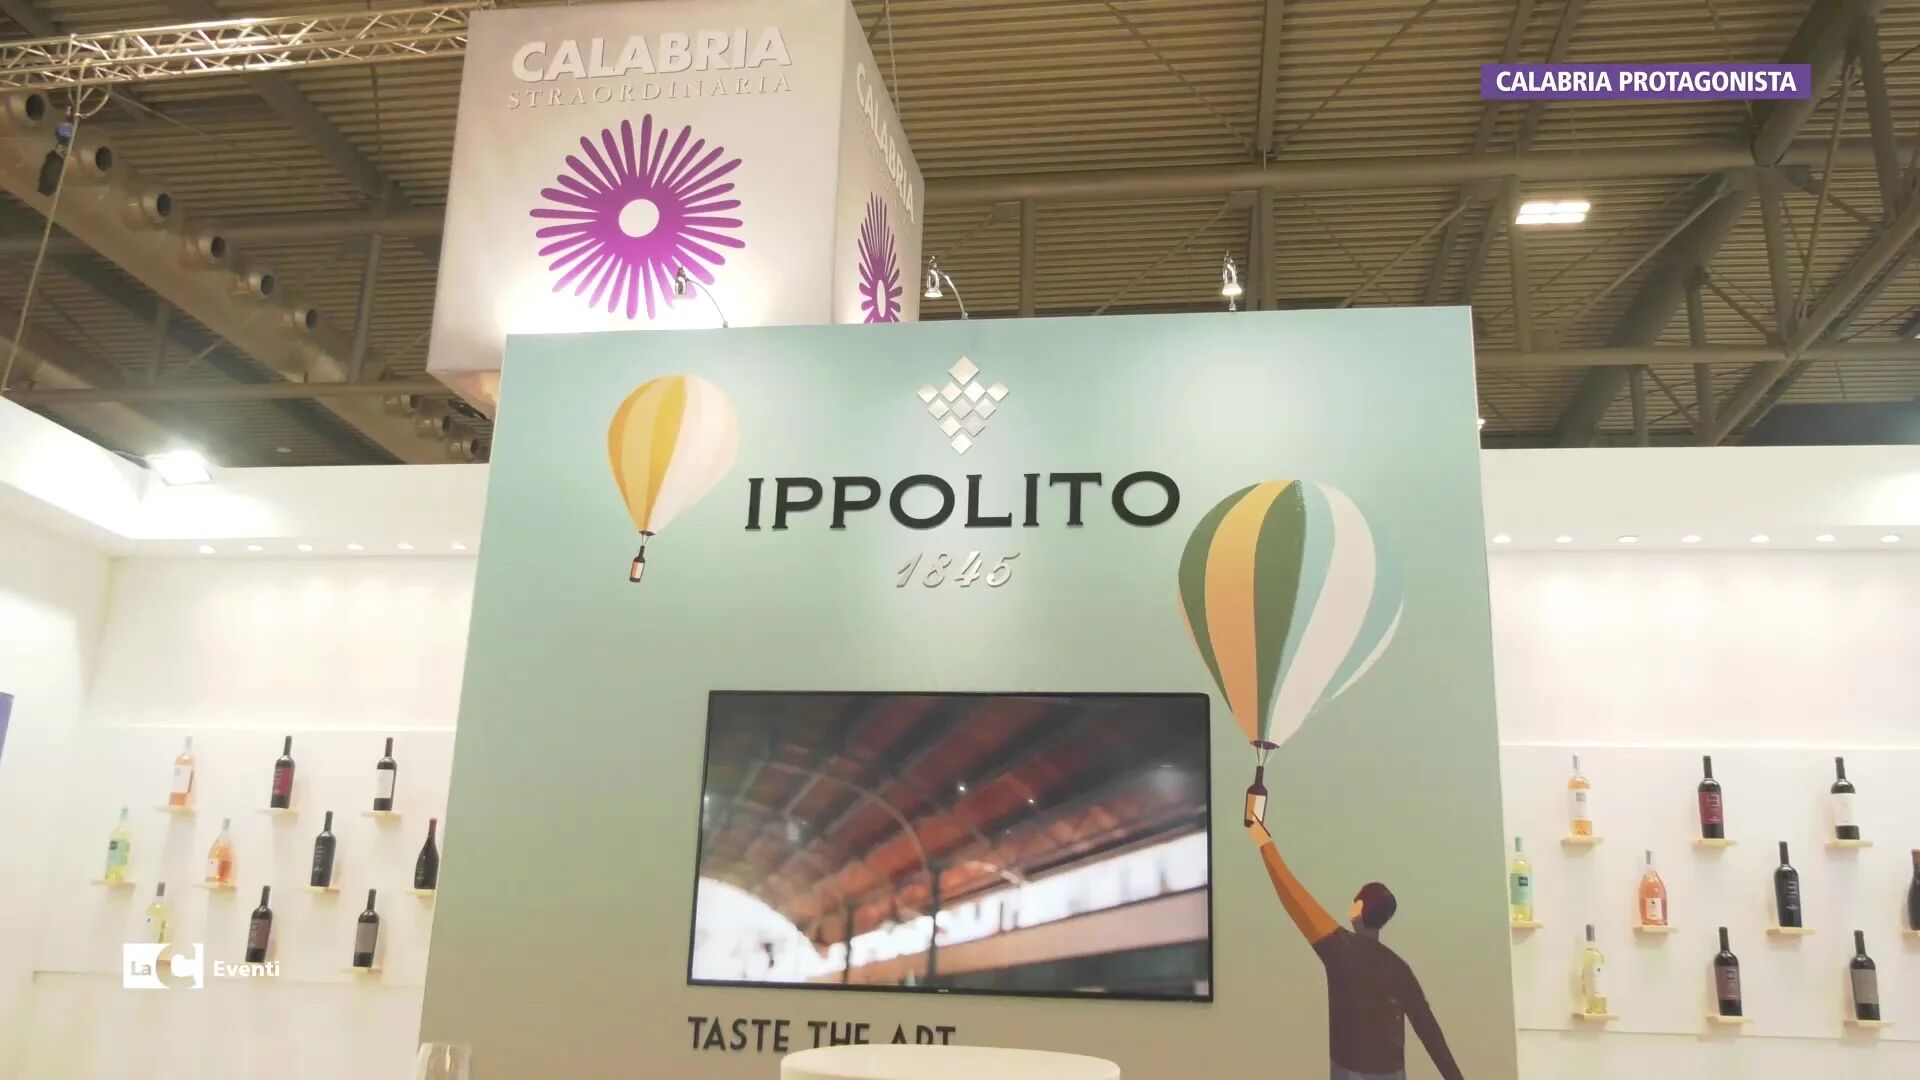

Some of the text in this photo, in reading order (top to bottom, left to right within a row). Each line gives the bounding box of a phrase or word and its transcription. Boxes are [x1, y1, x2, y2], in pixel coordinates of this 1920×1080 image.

[511, 26, 793, 83] CALABRIA
[507, 73, 793, 110] STRAORDINARIA
[856, 62, 915, 224] CALABRIA
[744, 470, 1181, 531] IPPOLITO
[896, 550, 1021, 588] 1845
[687, 1016, 790, 1053] TASTE
[807, 1021, 870, 1049] THE
